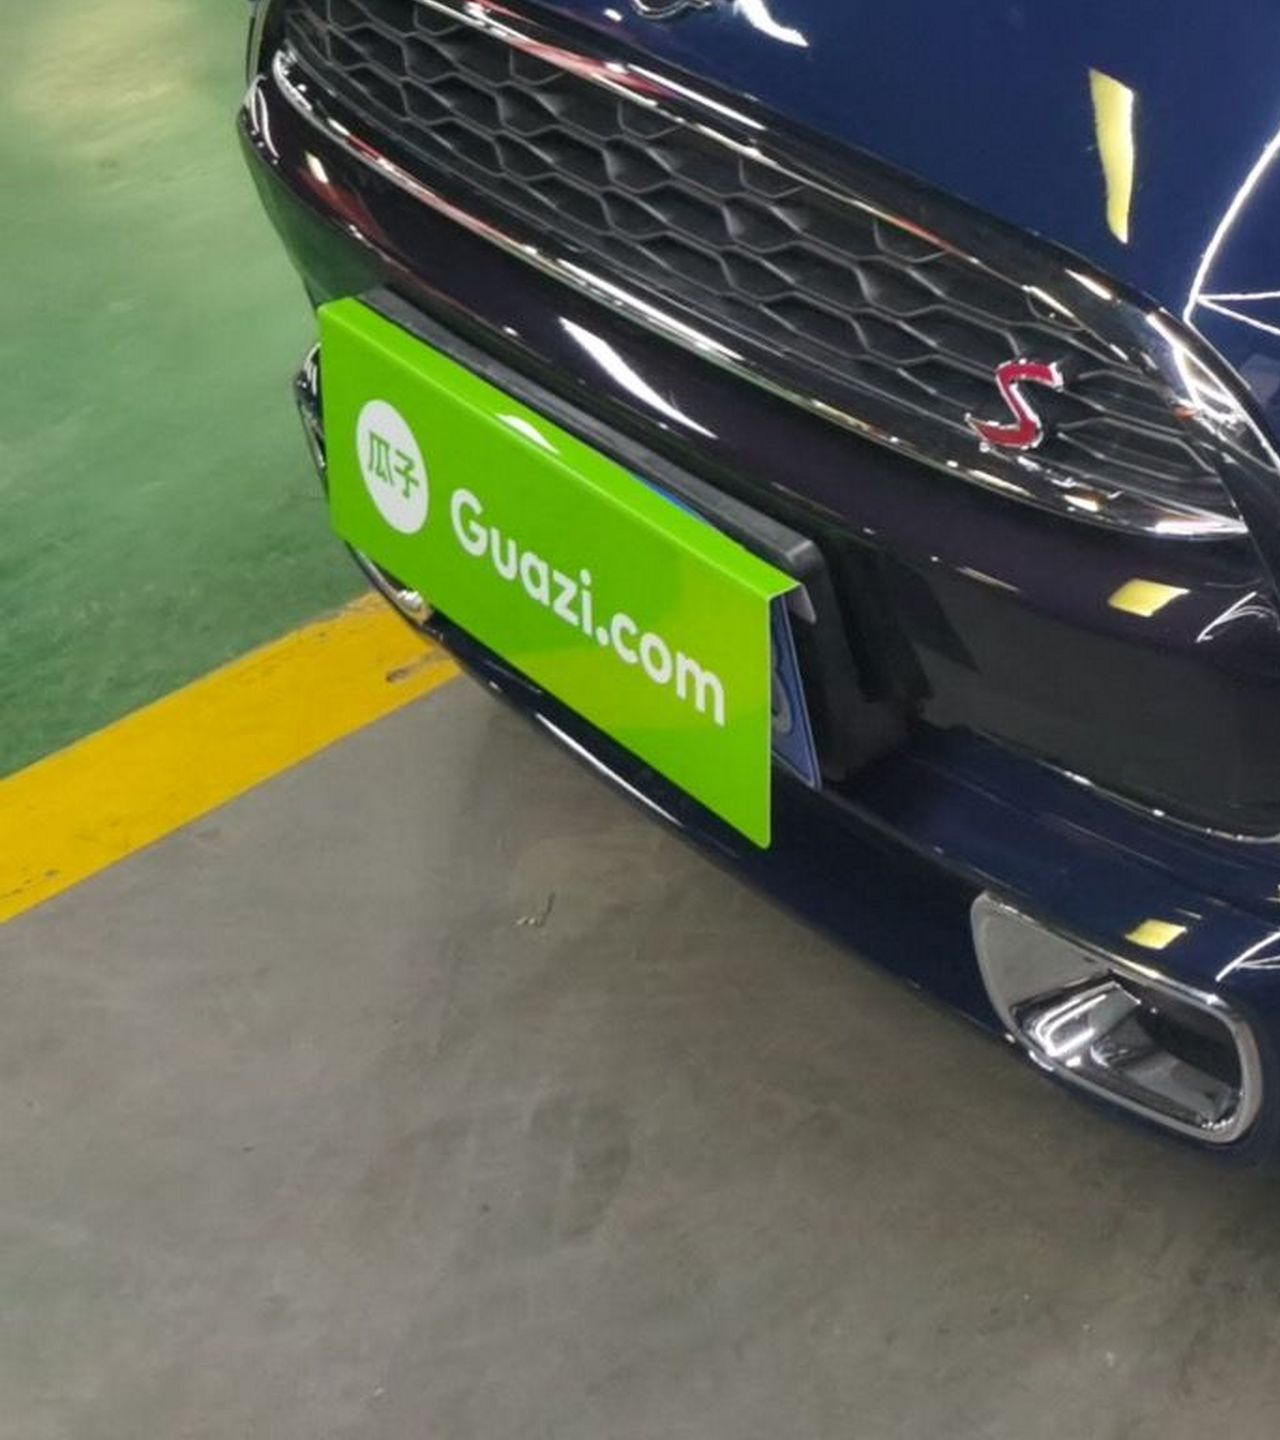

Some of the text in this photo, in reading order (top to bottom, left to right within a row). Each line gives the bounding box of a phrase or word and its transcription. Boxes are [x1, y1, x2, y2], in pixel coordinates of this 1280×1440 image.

[964, 358, 1064, 453] S
[367, 430, 422, 500] 瓜子
[450, 488, 726, 728] Guazi.com
